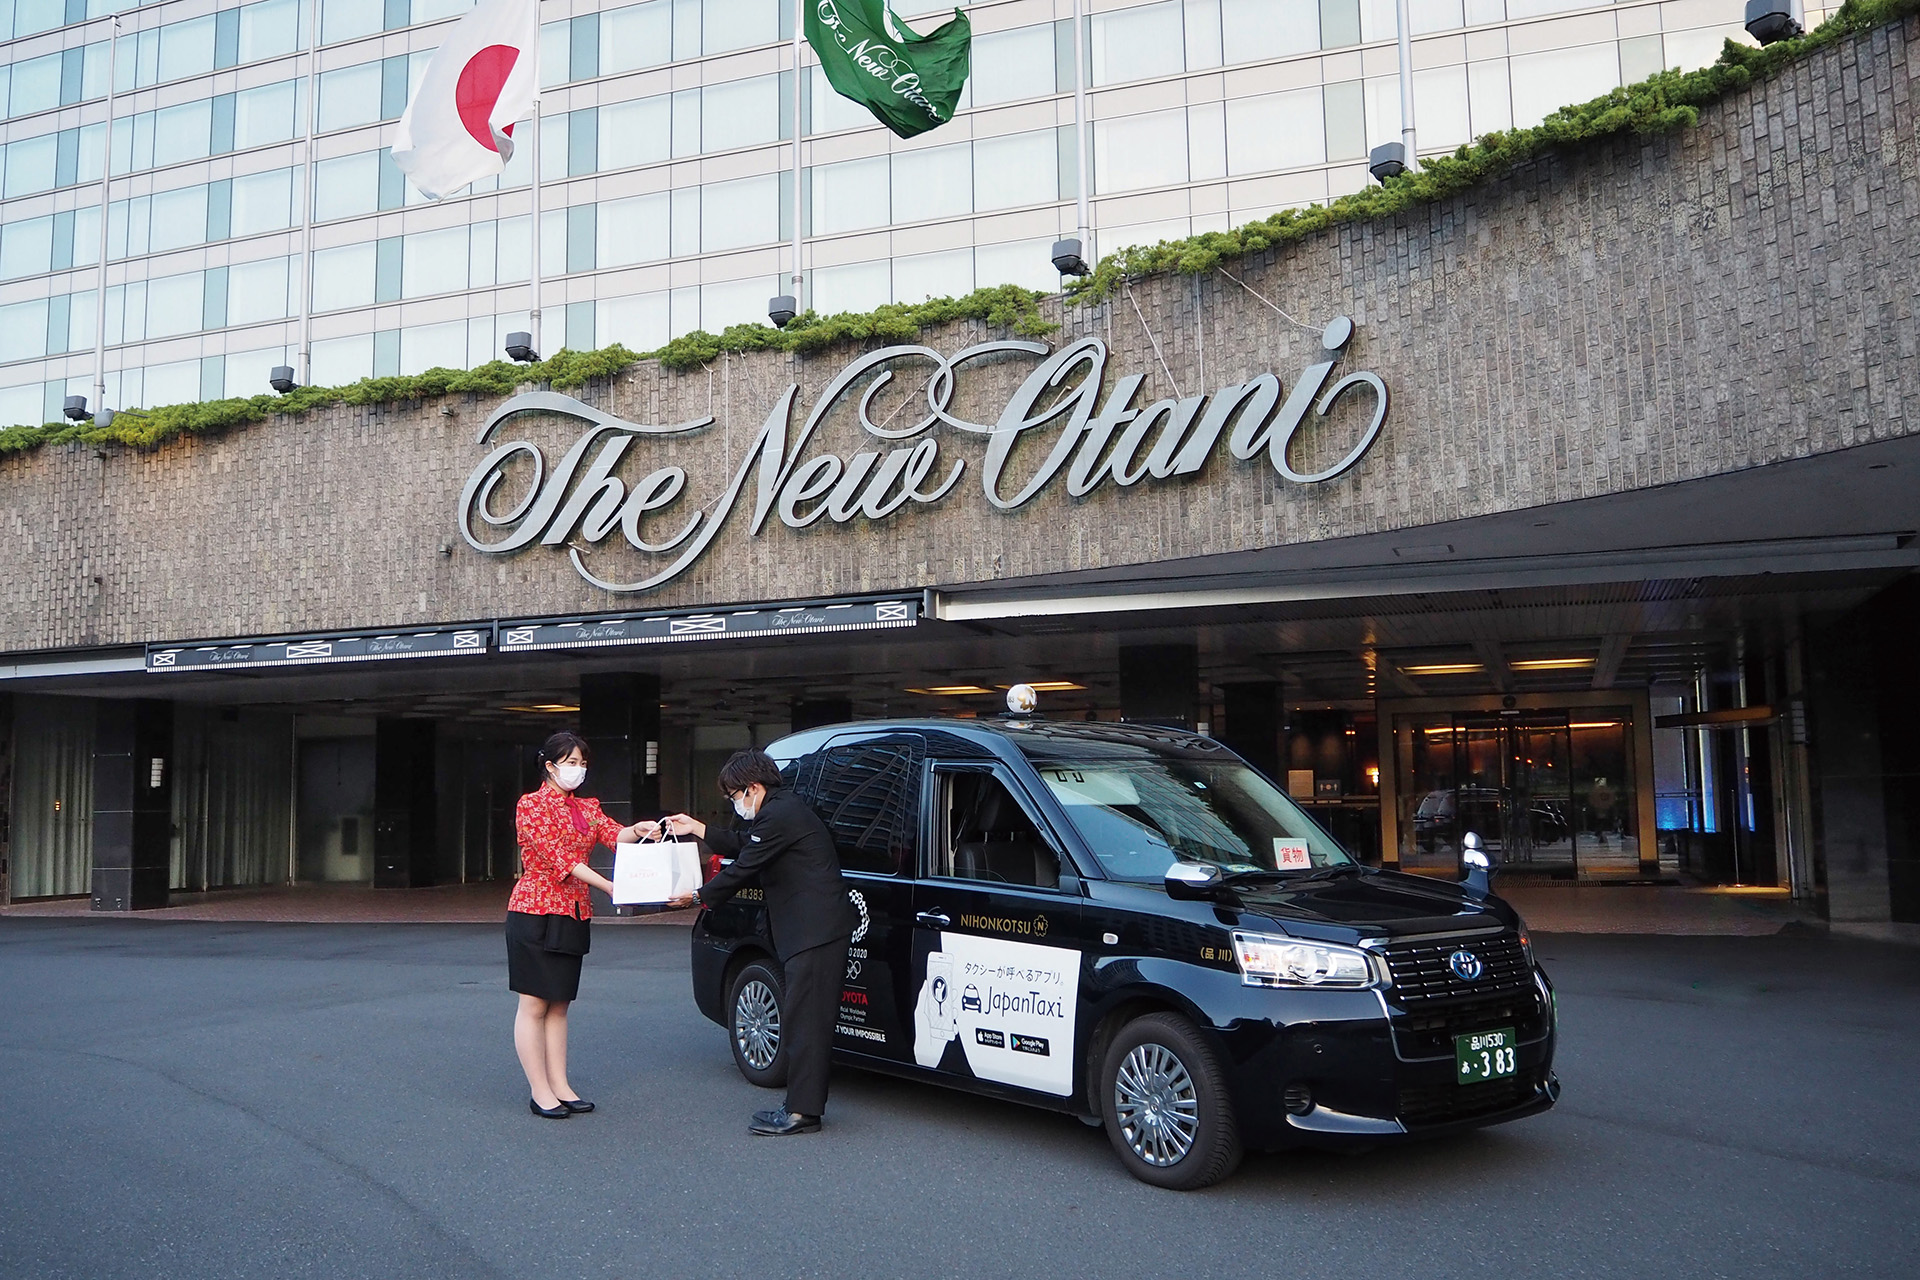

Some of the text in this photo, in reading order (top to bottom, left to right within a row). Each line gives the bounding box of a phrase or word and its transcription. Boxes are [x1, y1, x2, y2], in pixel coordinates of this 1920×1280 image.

[834, 33, 898, 81] New
[457, 315, 1390, 592] The New Otani
[771, 614, 788, 627] The
[801, 613, 828, 625] Otani
[1280, 846, 1304, 863] 貨物
[960, 913, 1032, 935] NIHONKOTSU
[852, 947, 868, 959] 2020
[841, 991, 869, 1006] YOTA
[984, 985, 1065, 1019] JapanTaxi
[840, 1025, 856, 1036] YOUR
[855, 1028, 887, 1043] IMPOSSIBLE
[1020, 1037, 1036, 1048] Google
[1035, 1040, 1045, 1050] Play
